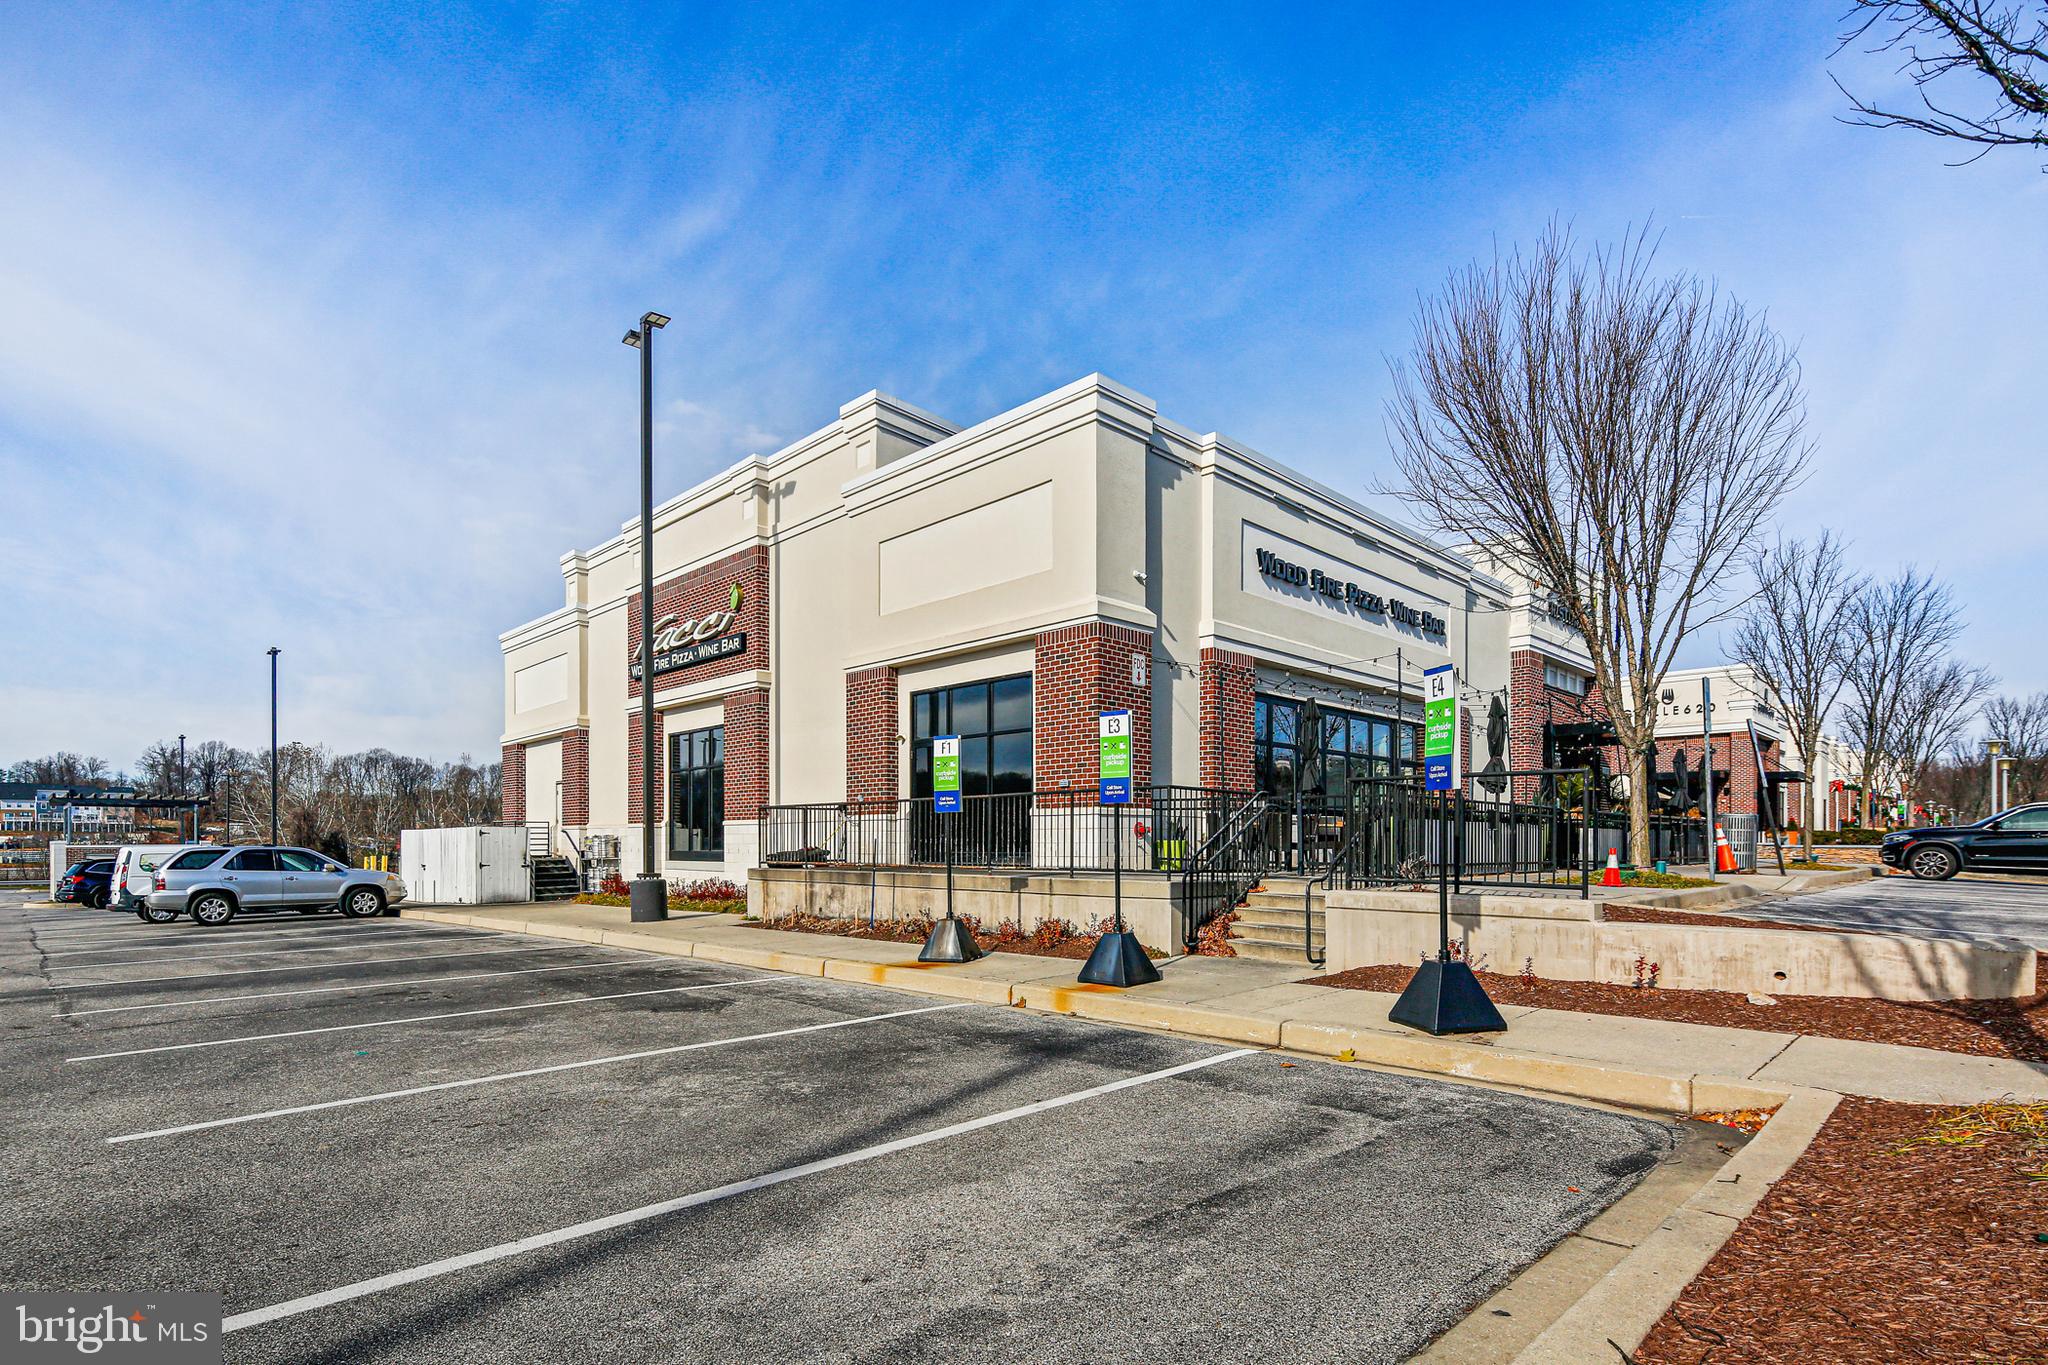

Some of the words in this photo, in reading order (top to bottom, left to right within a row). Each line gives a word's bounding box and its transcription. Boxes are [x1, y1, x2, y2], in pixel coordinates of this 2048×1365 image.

[1256, 547, 1309, 587] WOOD
[1310, 568, 1344, 600] FIRE
[1345, 582, 1387, 615] PIZZA
[1389, 598, 1422, 628] WINE
[1421, 610, 1447, 636] BAR
[653, 657, 670, 671] FIRE
[671, 652, 695, 667] PIZZA
[698, 642, 719, 659] WINE
[721, 637, 740, 652] BAR
[1133, 657, 1145, 670] FDC
[1432, 675, 1445, 698] E4
[1108, 717, 1121, 734] E3
[1428, 722, 1452, 734] curbside
[1430, 730, 1449, 741] pickup
[941, 741, 951, 755] F1
